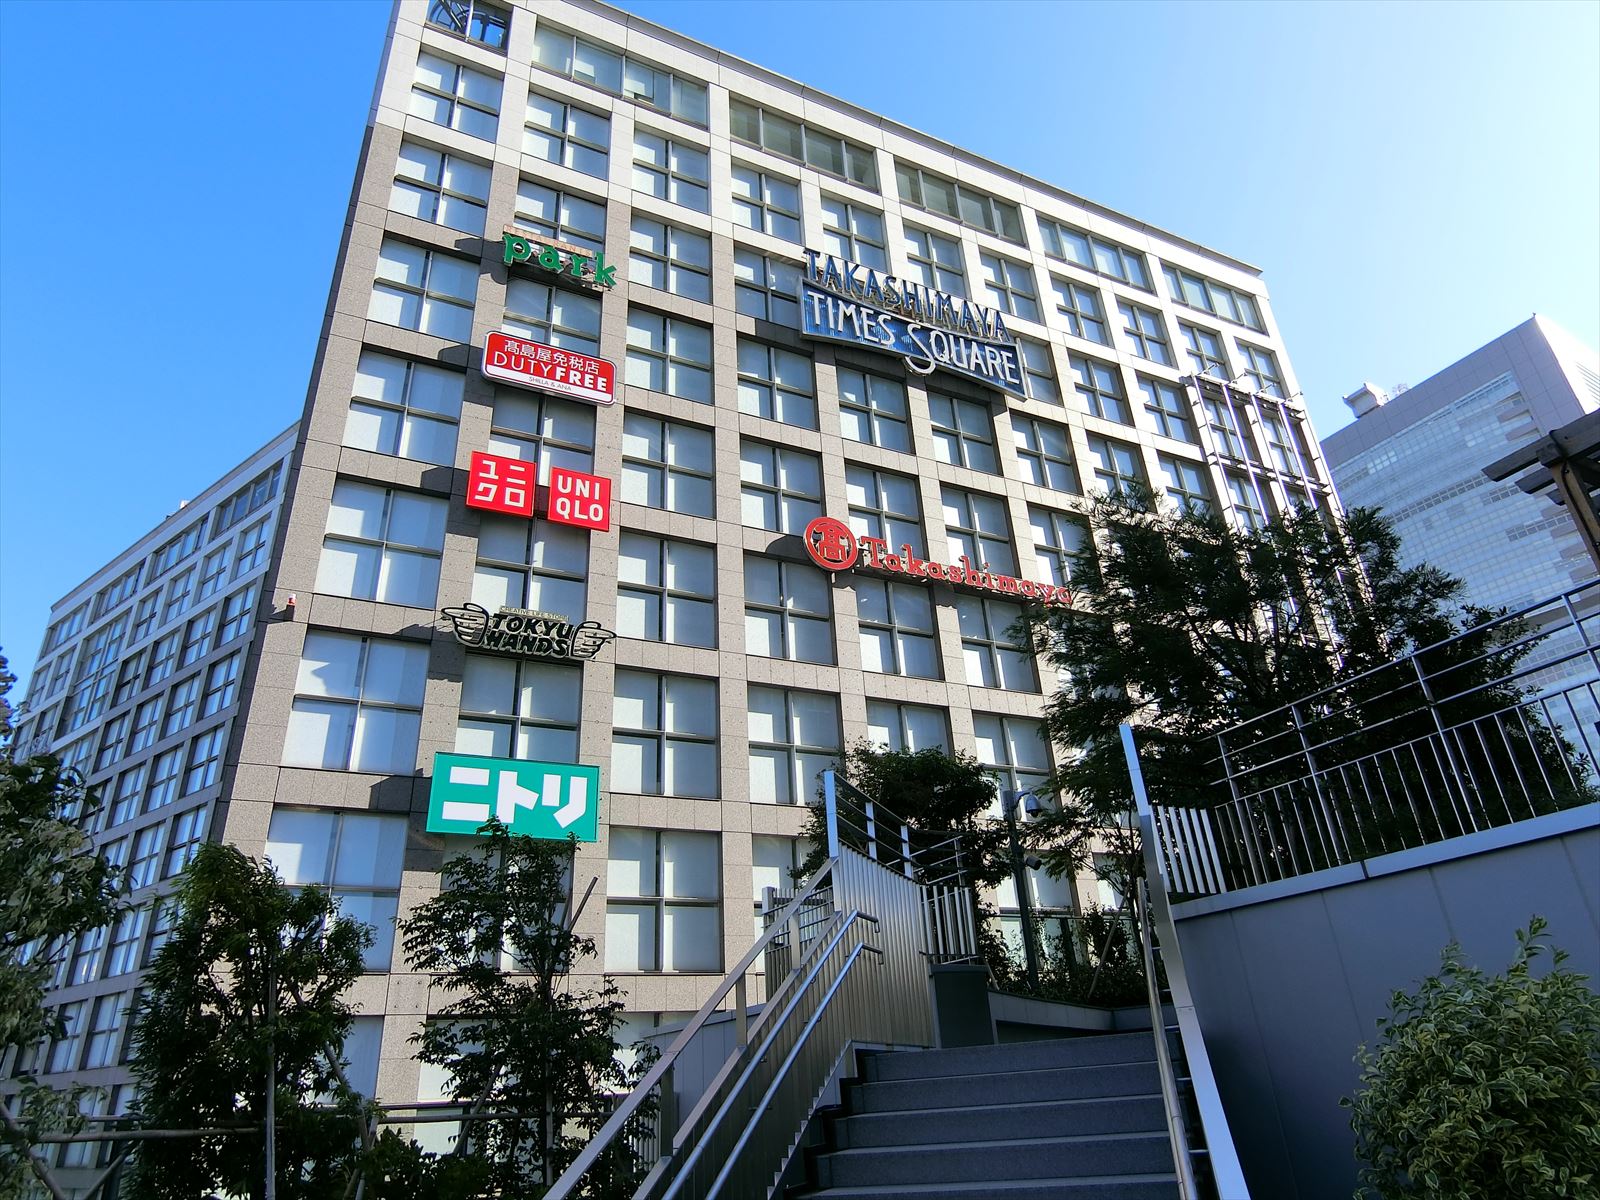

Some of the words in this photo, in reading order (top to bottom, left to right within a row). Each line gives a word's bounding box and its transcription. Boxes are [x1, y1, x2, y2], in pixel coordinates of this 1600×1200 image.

[502, 233, 617, 286] park
[803, 250, 1011, 342] TAKASHIMAYA
[807, 291, 895, 346] TIMES
[904, 323, 1020, 385] SQUARE
[860, 535, 1072, 608] Takashimaya
[483, 629, 569, 658] HANDS
[492, 613, 574, 640] TOKYU
[442, 766, 588, 829] ニトリ
